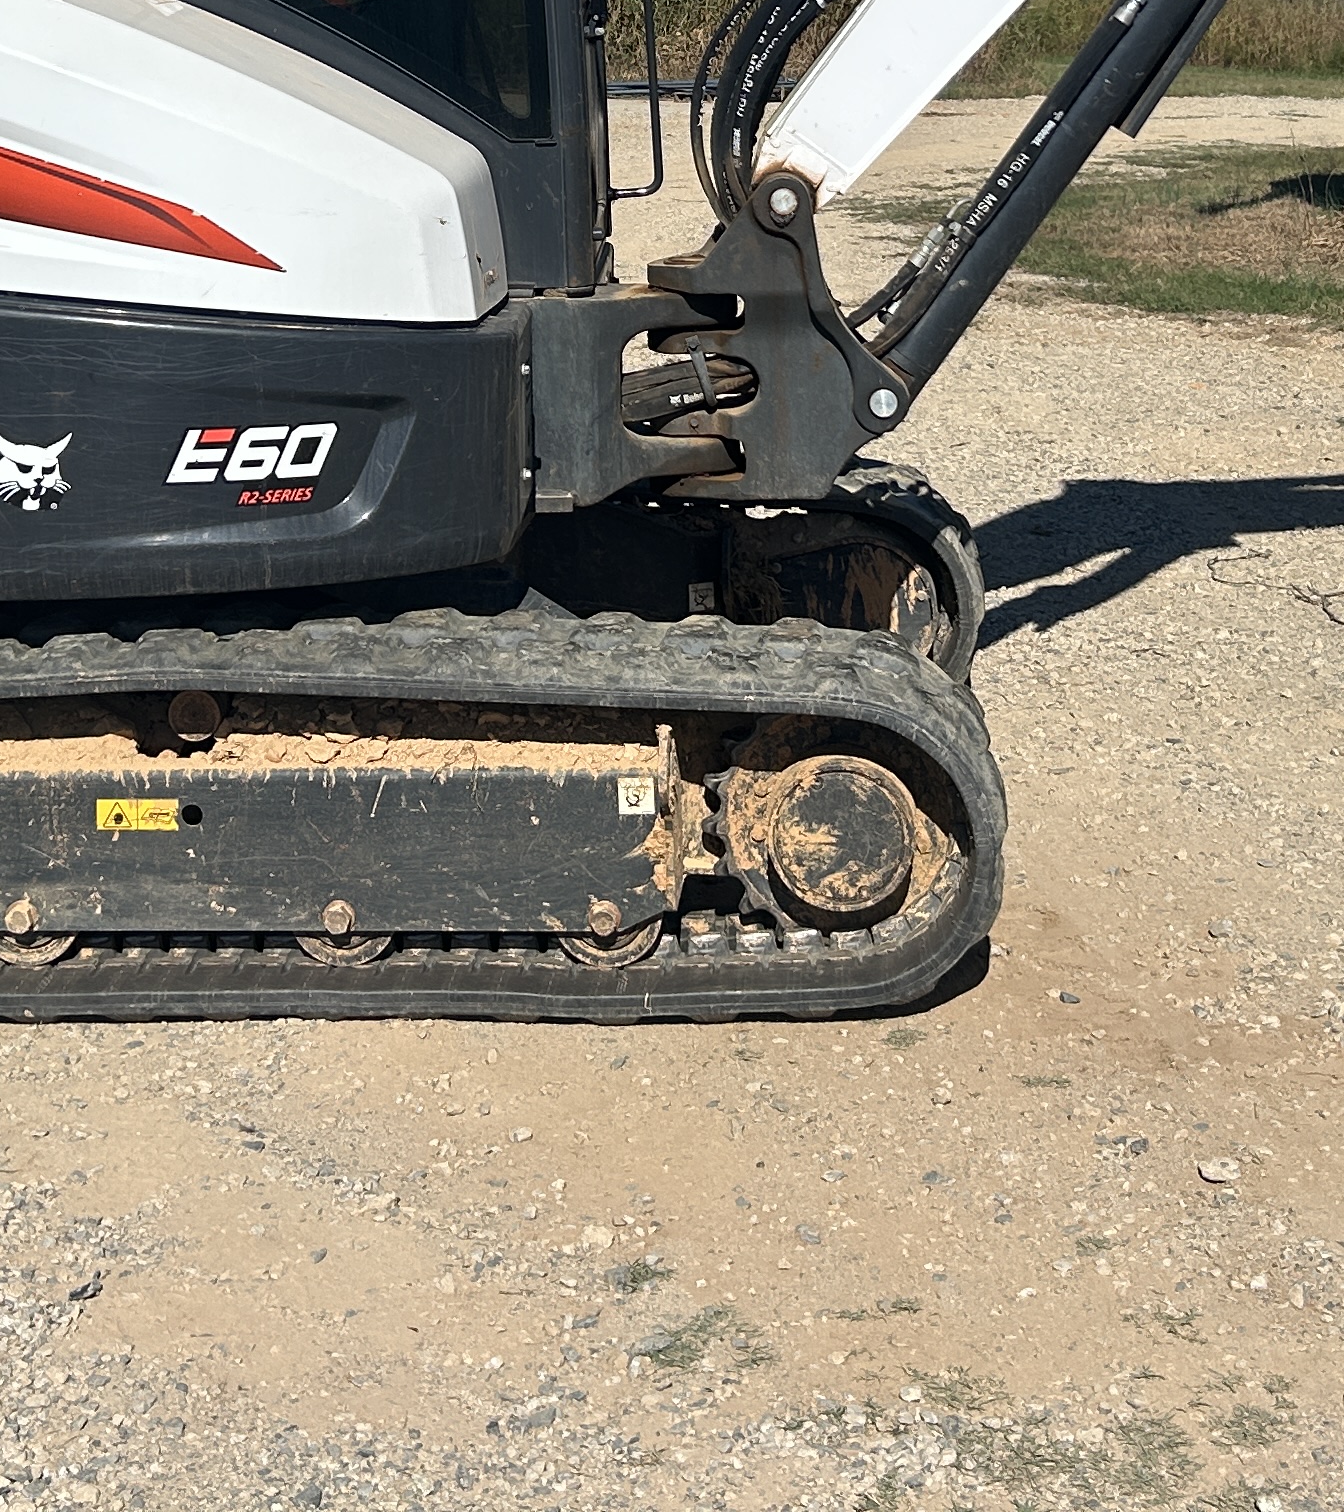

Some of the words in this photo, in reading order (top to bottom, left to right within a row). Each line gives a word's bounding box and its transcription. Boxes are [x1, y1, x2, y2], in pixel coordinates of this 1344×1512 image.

[996, 152, 1032, 189] HG-16
[965, 191, 999, 227] MSHA
[165, 422, 338, 484] E60
[238, 487, 314, 505] R2-SERIES
